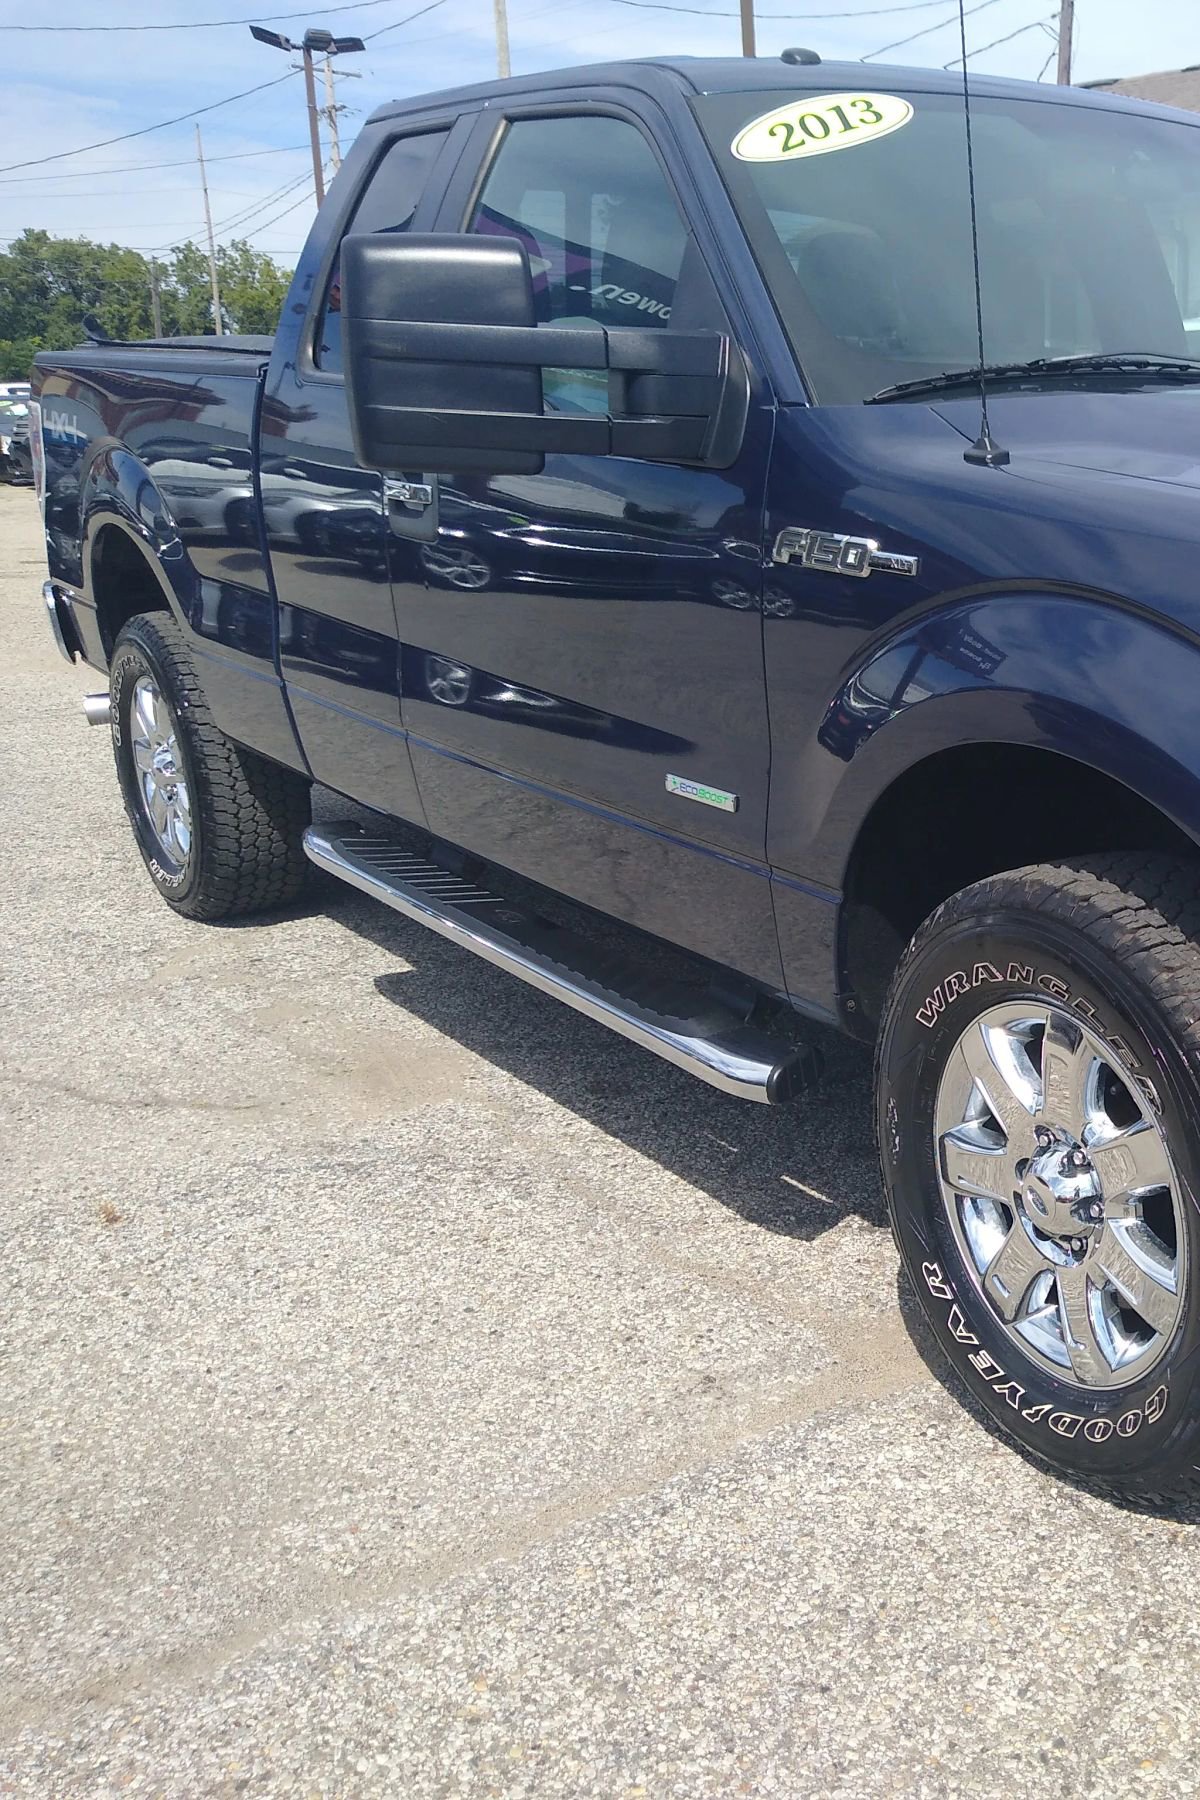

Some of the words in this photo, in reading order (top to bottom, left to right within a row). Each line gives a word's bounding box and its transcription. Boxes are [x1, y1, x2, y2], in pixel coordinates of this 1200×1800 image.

[768, 99, 883, 152] 2013
[916, 962, 1164, 1115] WRANGLER
[922, 1261, 1168, 1443] GOODYEAR
